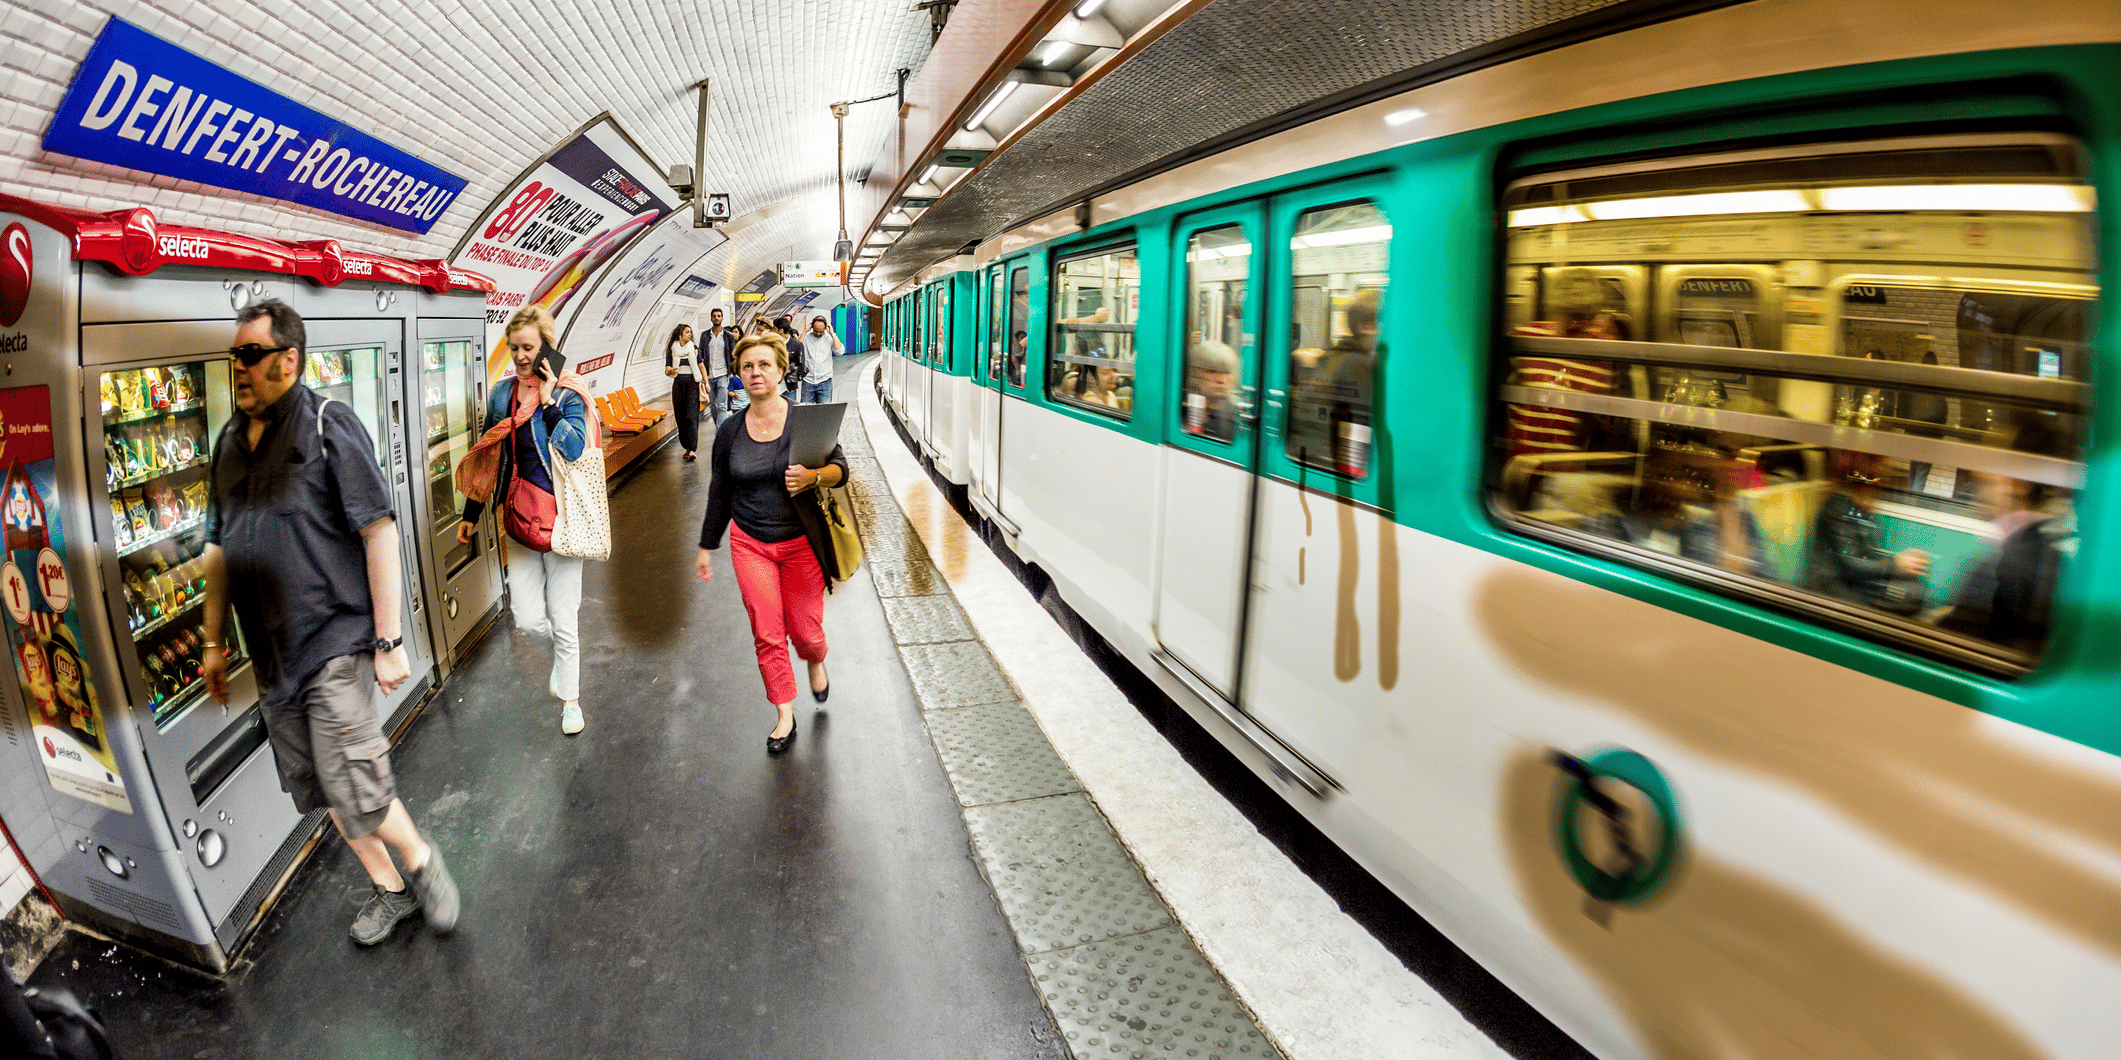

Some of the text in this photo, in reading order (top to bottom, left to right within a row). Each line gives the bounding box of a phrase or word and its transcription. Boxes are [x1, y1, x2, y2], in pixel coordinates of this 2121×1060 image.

[80, 59, 453, 221] DENFERT-ROCHEREAU
[538, 194, 605, 236] POUR ALLER
[158, 235, 209, 259] selecta
[513, 220, 577, 257] PLUS HAUT
[342, 257, 372, 275] selecta
[465, 242, 496, 262] PHASE
[493, 248, 523, 268] FINALE
[518, 253, 533, 269] DU
[528, 256, 547, 271] TOP
[503, 292, 526, 307] PARIS
[56, 745, 82, 762] selecta
